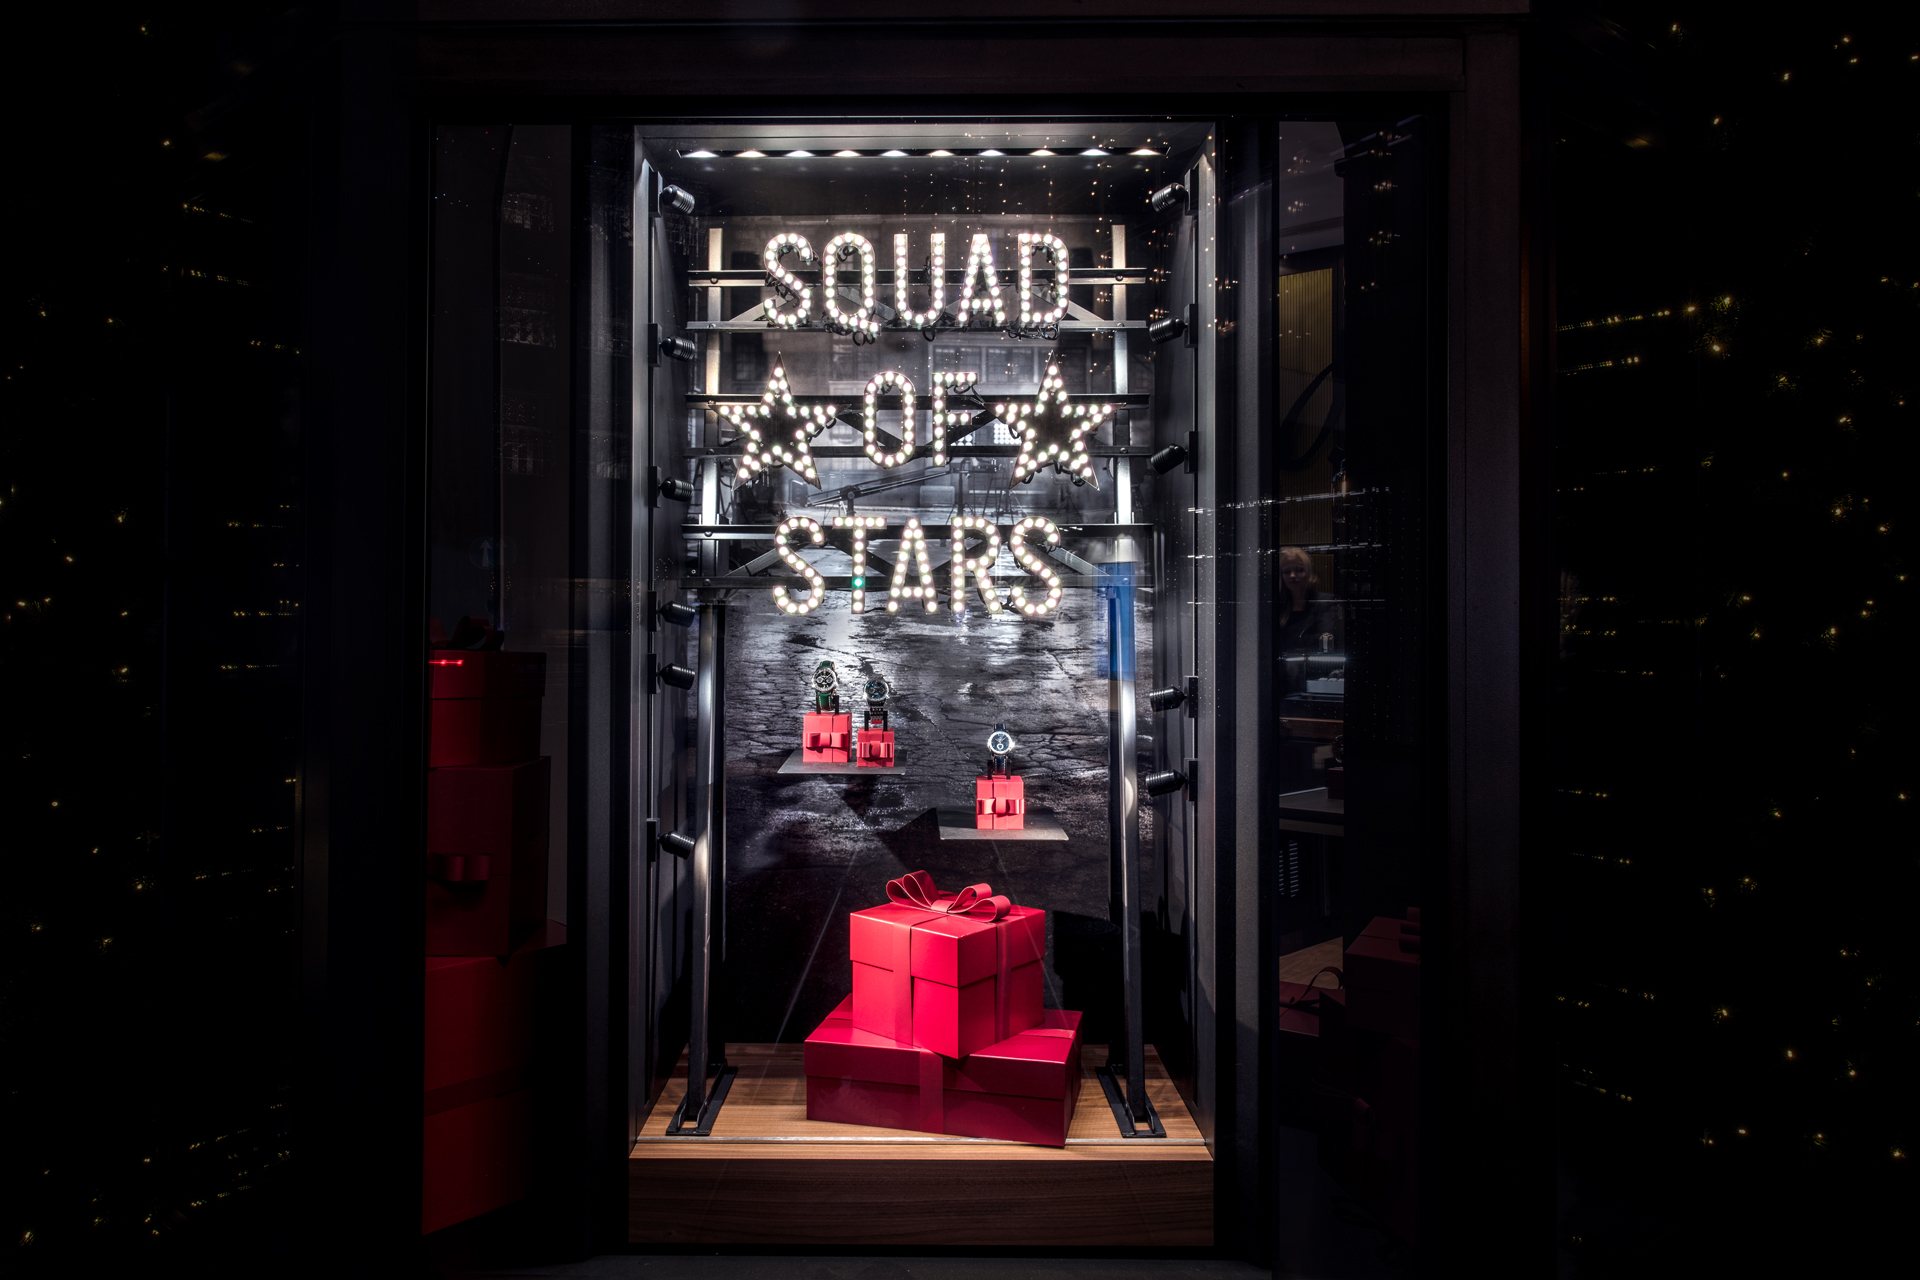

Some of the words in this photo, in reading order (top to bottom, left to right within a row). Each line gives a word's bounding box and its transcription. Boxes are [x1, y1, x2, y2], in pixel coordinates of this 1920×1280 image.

[764, 232, 1069, 337] SQUAD
[863, 371, 978, 468] OF
[772, 516, 1062, 616] STARS
